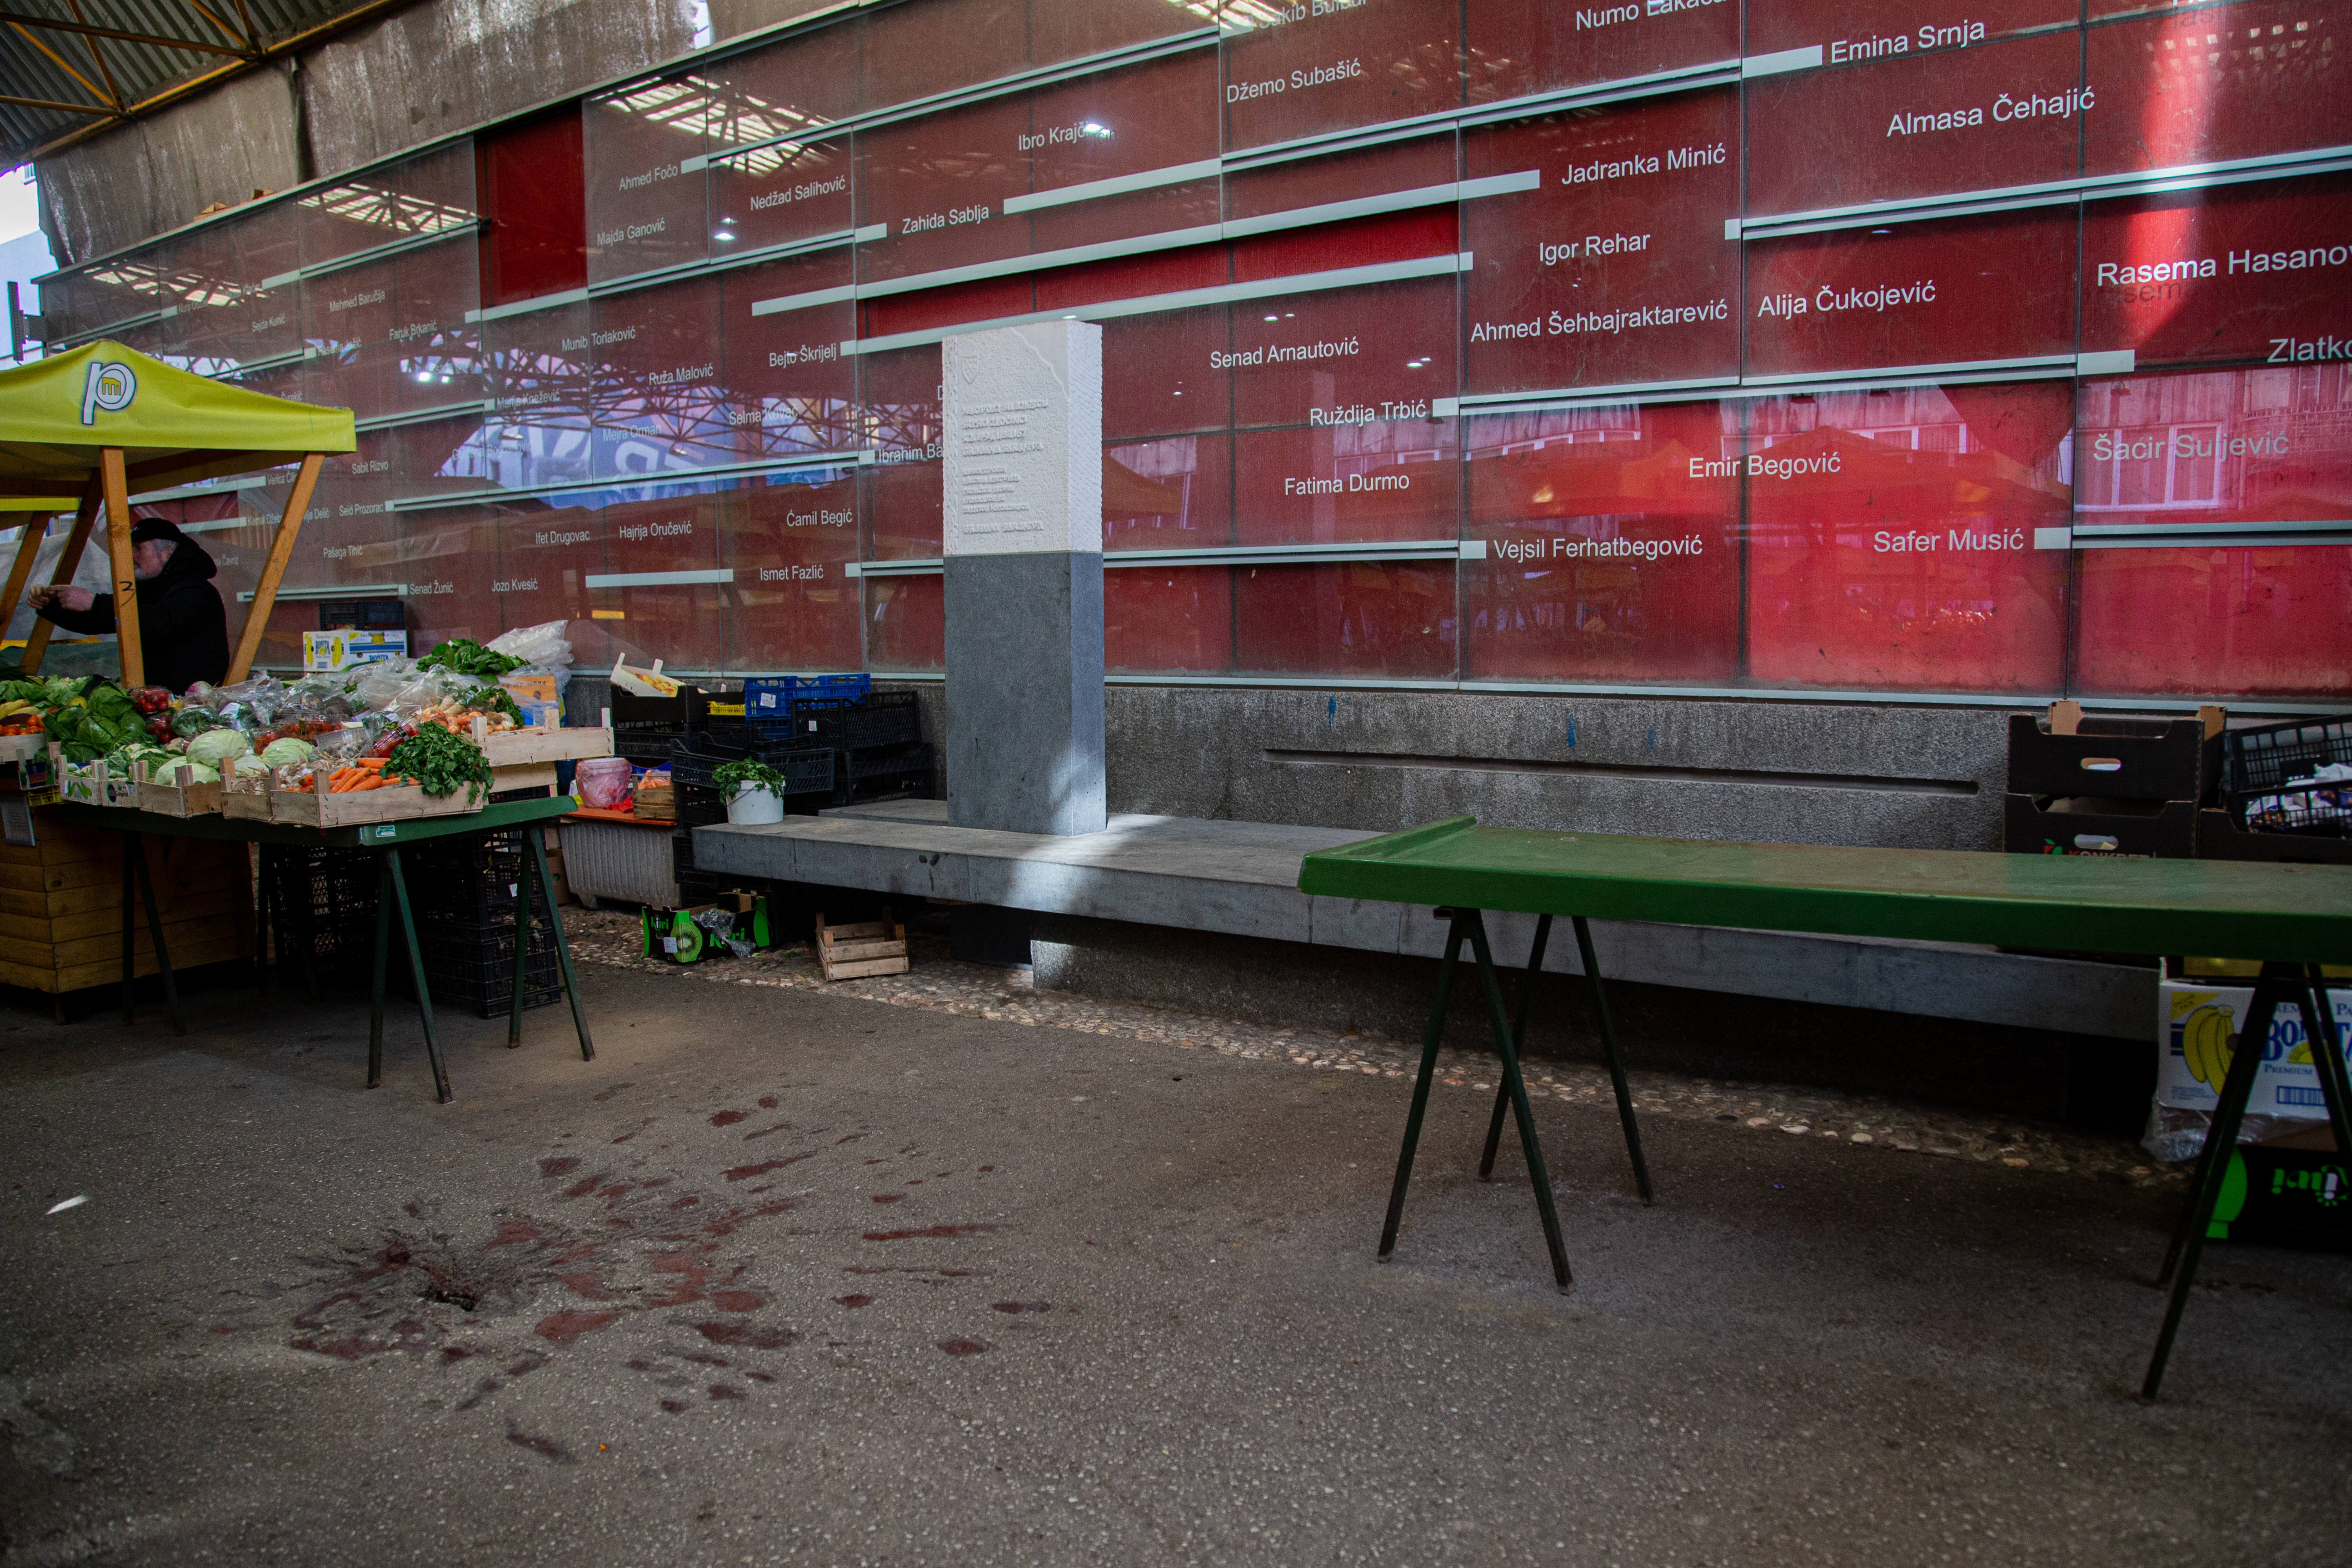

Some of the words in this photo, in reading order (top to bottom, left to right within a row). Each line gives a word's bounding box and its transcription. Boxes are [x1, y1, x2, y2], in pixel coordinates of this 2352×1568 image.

[1576, 4, 1639, 30] Numo
[1831, 33, 1908, 64] Emina
[1918, 19, 1985, 48] Srnja
[1227, 80, 1285, 103] Džemo
[1291, 58, 1361, 89] Subašić
[1887, 107, 1982, 137] Almasa
[1993, 86, 2095, 122] Čehajić
[1019, 134, 1044, 151] Ibro
[1562, 155, 1659, 185] Jadranka
[1668, 143, 1725, 170] Minić
[619, 167, 651, 191] Ahmed
[654, 163, 679, 180] Fočo
[750, 186, 792, 211] Nedžad
[794, 174, 845, 200] Salihović
[902, 214, 945, 234] Zahida
[949, 204, 989, 225] Sablja
[597, 228, 624, 247] Majda
[627, 218, 666, 239] Ganović
[1540, 242, 1578, 266] Igor
[1586, 233, 1650, 256] Rehar
[2098, 258, 2216, 286] Rasema
[2228, 245, 2352, 275] Hasano
[329, 298, 357, 313] Mehmed
[1758, 293, 1807, 320] Alija
[1816, 280, 1936, 313] Čukojević
[390, 327, 409, 340] Faruk
[1471, 318, 1541, 343] Ahmed
[1548, 300, 1728, 335] Šehbajraktarević
[562, 336, 588, 352] Munib
[591, 327, 636, 346] Torlaković
[769, 353, 797, 369] Bejto
[800, 343, 837, 365] Škrijelj
[1210, 346, 1263, 369] Senad
[1267, 336, 1359, 363] Arnautović
[649, 371, 674, 386] Ruža
[675, 364, 714, 382] Malović
[729, 410, 761, 424] Selma
[1310, 407, 1375, 427] Ruždija
[1380, 398, 1427, 419] Trbić
[603, 428, 628, 443] Mejra
[630, 424, 661, 437] Orman
[2093, 434, 2165, 461] Šaćir
[2175, 431, 2290, 461] Suljević
[879, 447, 923, 464] Ibrahim
[926, 444, 943, 459] Ba
[1689, 456, 1741, 478] Emir
[1748, 452, 1841, 479] Begović
[352, 463, 369, 474] Sabit
[370, 460, 389, 472] Rizvo
[1285, 478, 1343, 496] Fatima
[1349, 473, 1410, 492] Durmo
[339, 505, 354, 516] Seid
[355, 503, 384, 515] Prozorac
[787, 509, 817, 527] Ćamil
[821, 508, 852, 527] Begić
[535, 533, 548, 546] Ifet
[550, 529, 590, 544] Drugovac
[619, 526, 648, 542] Hajrija
[650, 521, 692, 537] Oručević
[1874, 531, 1940, 553] Safer
[1948, 529, 2024, 551] Musić
[323, 546, 346, 560] Pašaga
[1494, 539, 1545, 563] Vejsil
[1553, 535, 1703, 561] Ferhatbegović
[760, 567, 789, 580] Ismet
[792, 564, 824, 579] Fazlić
[410, 584, 432, 595] Senad
[434, 581, 454, 594] Žunić
[492, 580, 509, 592] Jozo
[511, 578, 538, 591] Kvesić
[651, 914, 669, 932] Kiwi
